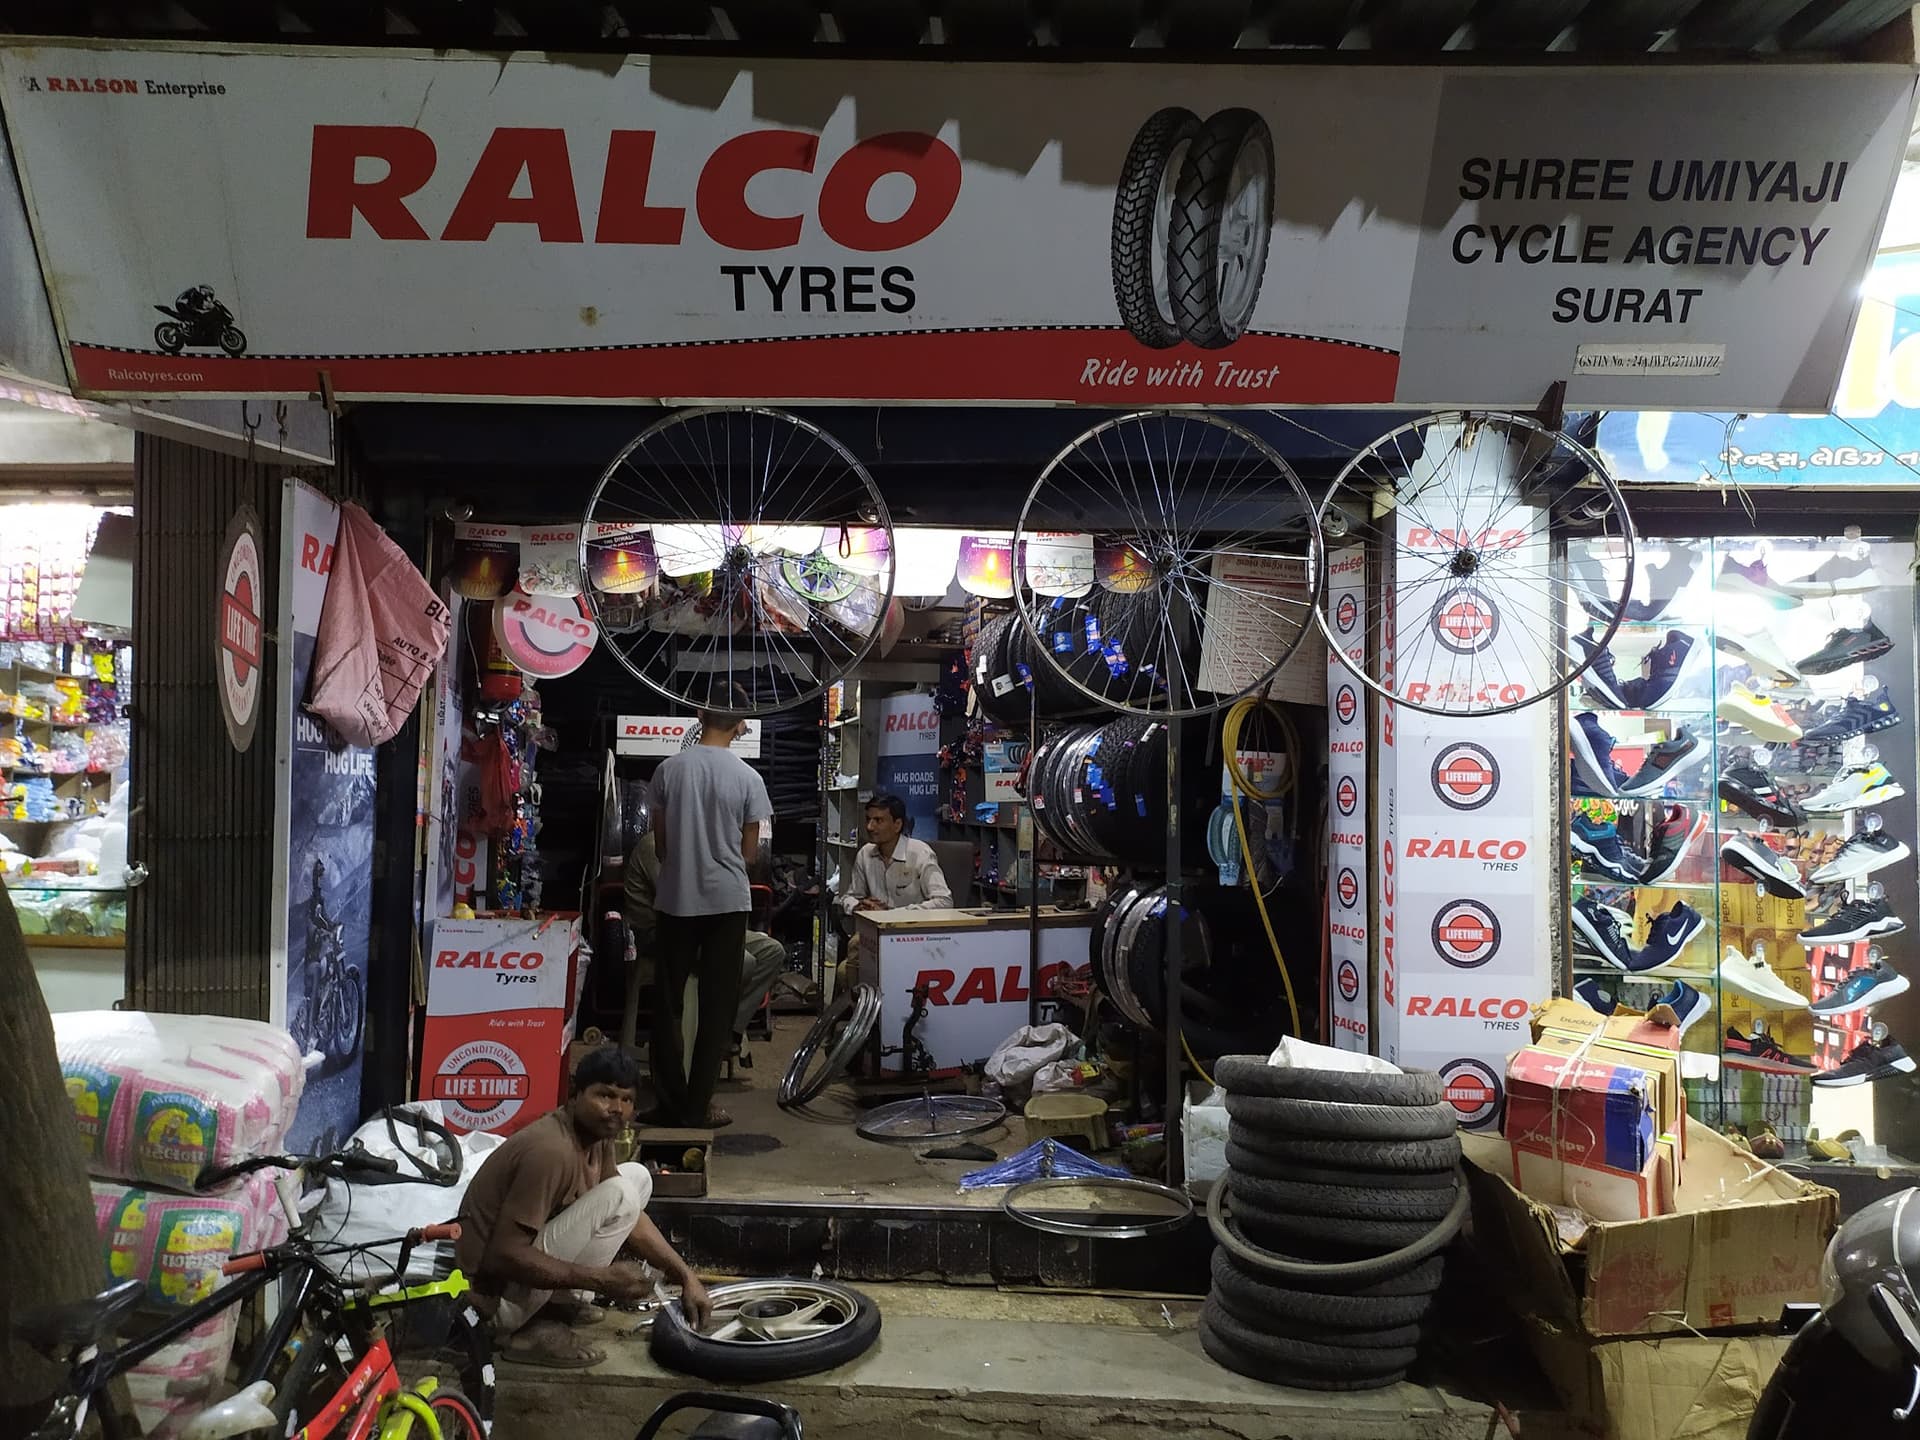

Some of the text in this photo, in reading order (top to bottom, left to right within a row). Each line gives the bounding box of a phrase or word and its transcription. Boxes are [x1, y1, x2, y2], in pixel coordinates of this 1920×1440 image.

[28, 77, 226, 98] A RALSON Enterprise
[306, 124, 962, 252] RALCO
[1458, 158, 1848, 203] SHREE UMIYAJI
[1452, 225, 1830, 267] CYCLE AGENCY
[720, 265, 916, 314] TYRES
[1552, 288, 1702, 324] SURAT
[1579, 355, 1608, 367] GSTIN
[108, 368, 204, 383] Ralcotyres.com
[1079, 358, 1280, 389] Ride with Trust
[530, 532, 575, 542] RALCO
[1406, 528, 1527, 549] RALCO
[512, 599, 591, 639] RALCO
[393, 637, 420, 657] AUTO
[625, 725, 684, 736] RALCO
[885, 711, 940, 733] RALCO
[1330, 741, 1364, 753] RALCO
[324, 751, 374, 776] HUG LIFE
[894, 772, 935, 783] HUG ROADS
[1445, 771, 1483, 783] LIFETIME
[909, 785, 925, 796] HUG
[1387, 787, 1395, 835] TYRES
[1330, 832, 1364, 846] RALCO
[1405, 838, 1527, 860] RALCO
[1481, 862, 1519, 872] TYRES
[1722, 889, 1732, 923] PEPCO
[1786, 898, 1795, 925] PEPC
[1331, 923, 1365, 939] RALCO
[1384, 839, 1396, 1008] RALCO
[1445, 928, 1484, 940] LIFETIME
[435, 950, 544, 970] RALCO
[496, 973, 537, 984] Tyres
[1406, 995, 1528, 1019] RALCO
[489, 1018, 545, 1028] Ride with Trust
[1333, 1015, 1366, 1034] RALCO
[1483, 1021, 1519, 1031] TYRES
[447, 1045, 517, 1070] UNCONDITIONAL
[445, 1078, 518, 1096] LIFE TIME
[1446, 1088, 1485, 1100] LIFETIME
[451, 1108, 507, 1127] WARRANTY
